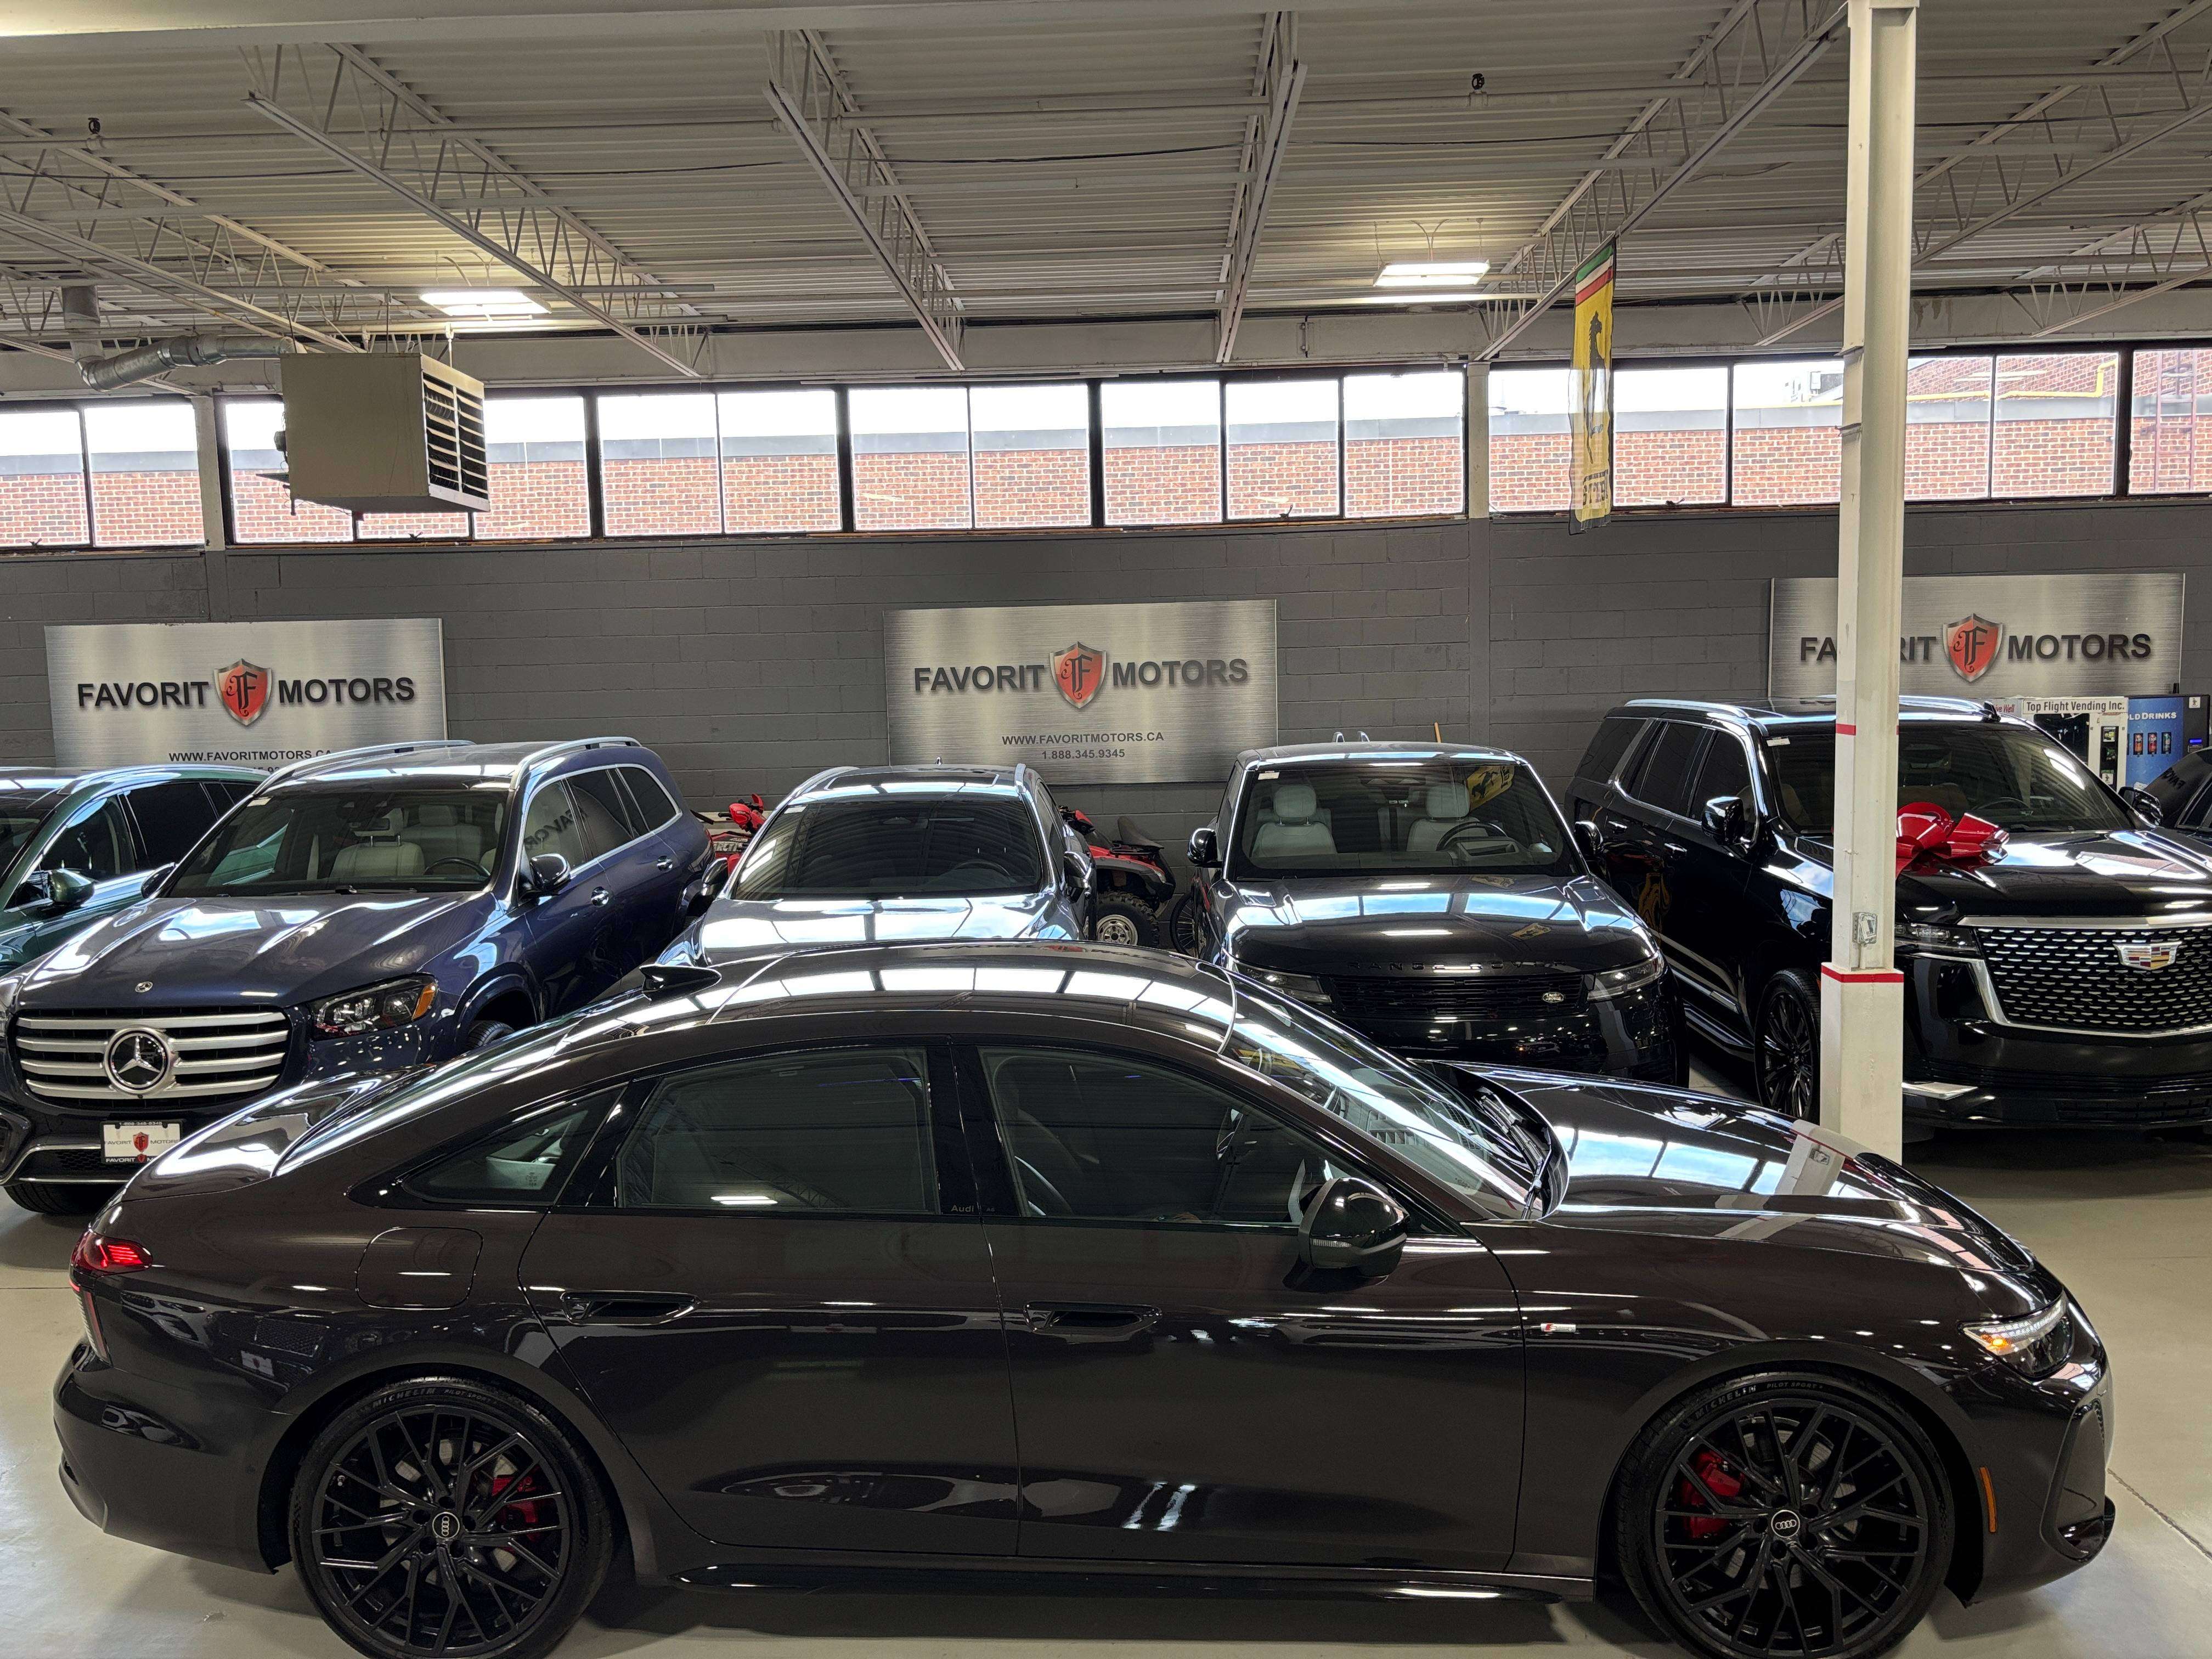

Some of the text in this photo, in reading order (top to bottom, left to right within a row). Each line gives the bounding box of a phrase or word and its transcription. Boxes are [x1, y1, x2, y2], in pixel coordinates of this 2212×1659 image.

[1801, 633, 2151, 661] FAIT MOTORS
[914, 658, 1248, 691] FAVORIT MOTORS
[77, 677, 415, 707] FAVORIT MOTORS
[2027, 701, 2125, 713] Top Flight Vending Inc.
[2141, 712, 2177, 720] DRINKS
[1002, 732, 1164, 746] WWW.FAVORITMOTORS.CA
[1042, 748, 1125, 759] 1.888.345.9345
[373, 1387, 436, 1409] MICHELIN
[1695, 1385, 1757, 1420] MICHELIN
